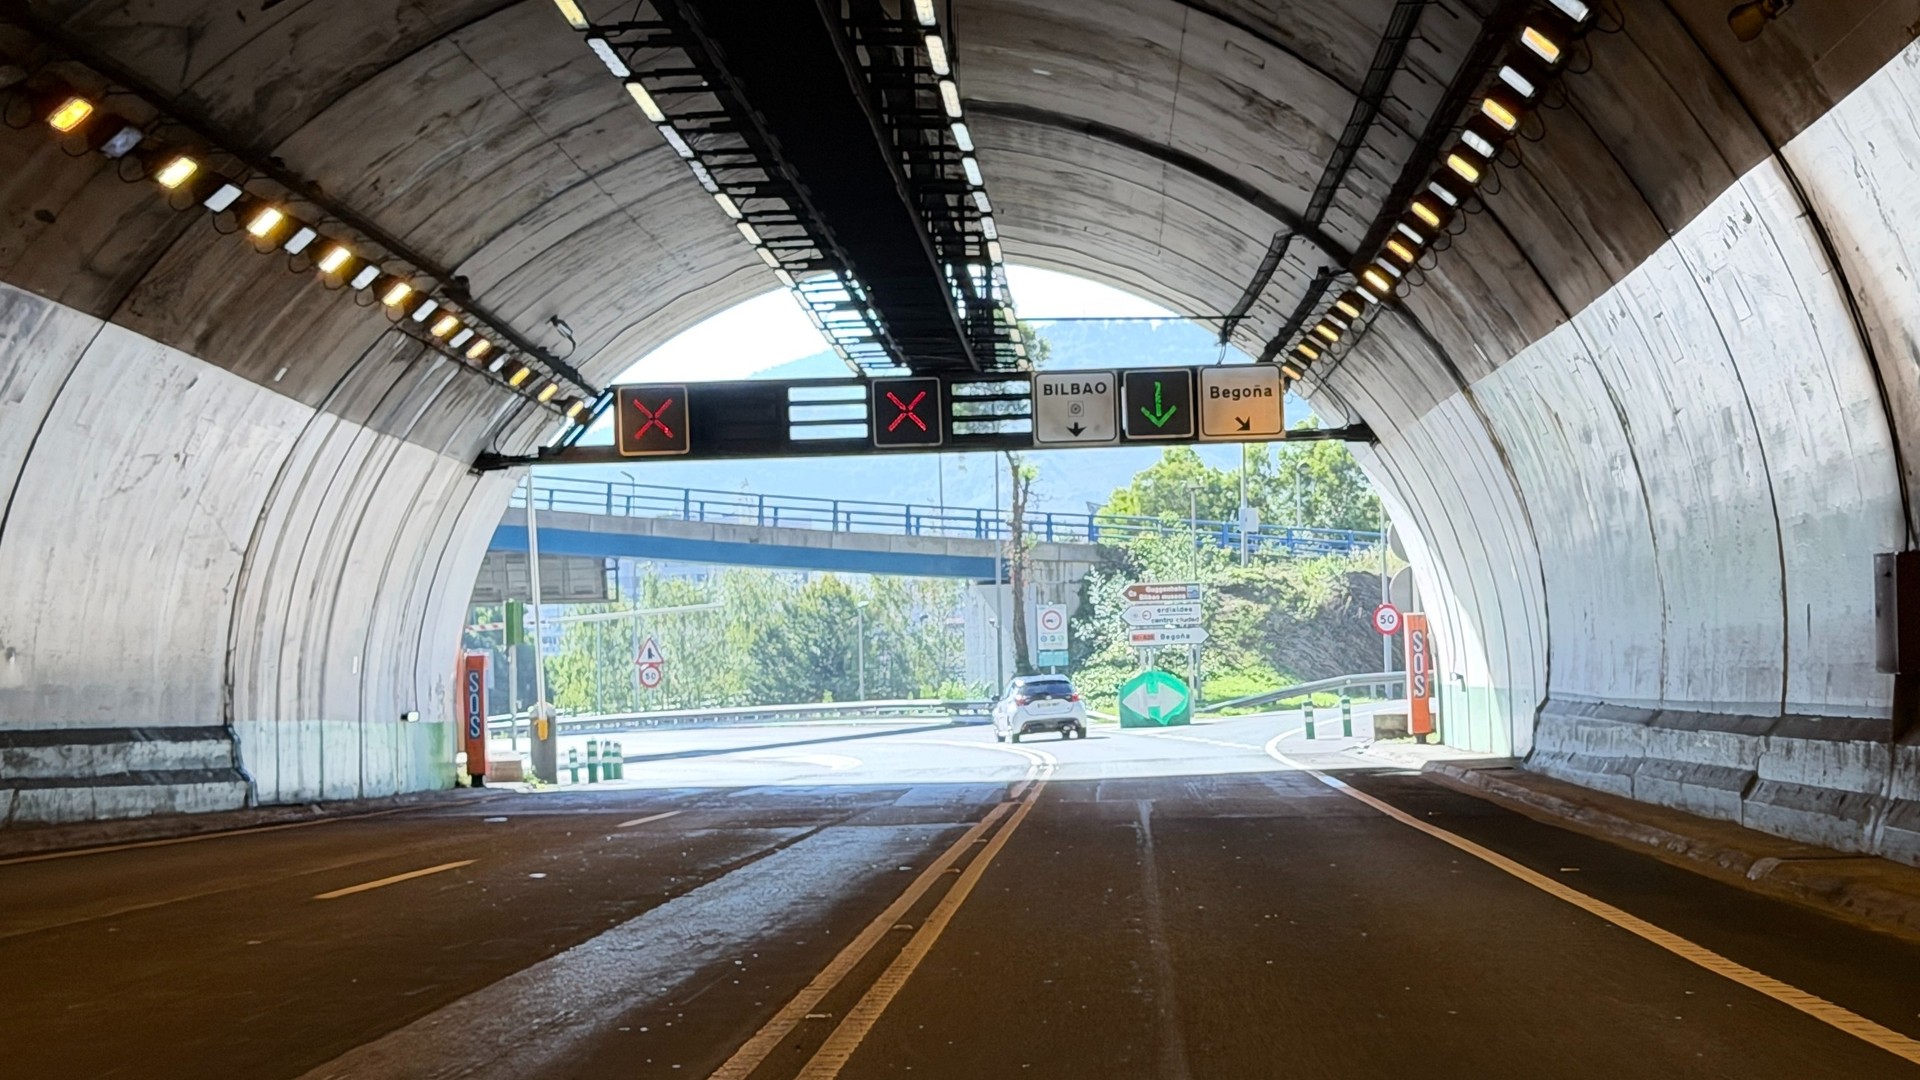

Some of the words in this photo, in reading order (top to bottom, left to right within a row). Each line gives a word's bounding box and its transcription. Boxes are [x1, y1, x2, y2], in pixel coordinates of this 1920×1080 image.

[1043, 381, 1107, 396] BILBAO
[1209, 384, 1273, 401] Begoña
[1380, 614, 1394, 624] 50
[1412, 630, 1425, 697] SOS
[469, 672, 481, 738] SOS
